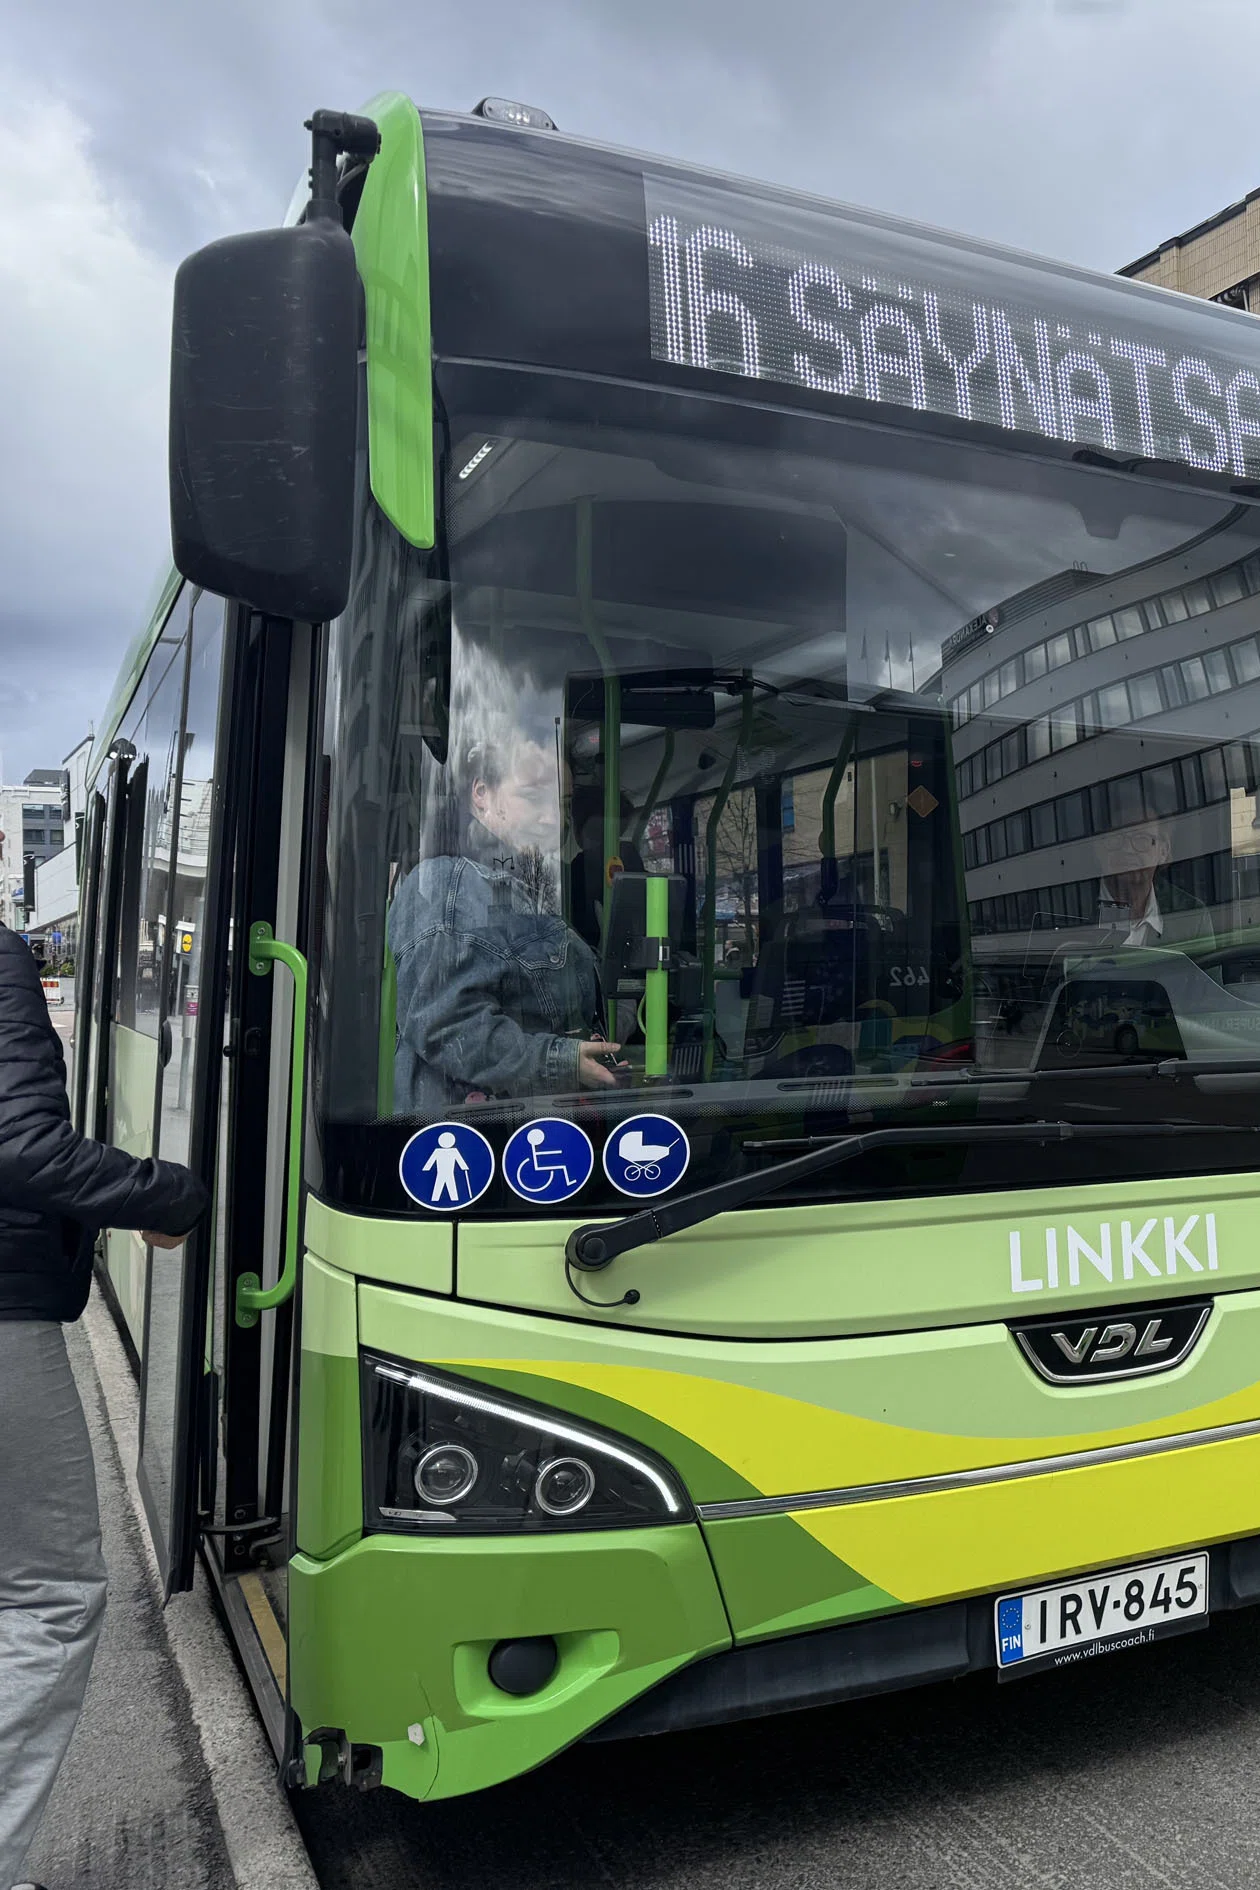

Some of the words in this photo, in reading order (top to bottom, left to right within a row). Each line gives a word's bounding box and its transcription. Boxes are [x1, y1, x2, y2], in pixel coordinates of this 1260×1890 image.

[648, 213, 761, 376] 16
[1009, 1213, 1219, 1293] LINKKI
[1050, 1319, 1174, 1364] VDL
[1039, 1565, 1199, 1644] IRV-845
[1000, 1633, 1022, 1653] FIN
[1053, 1628, 1155, 1667] www.vdlbuscoach.fi
